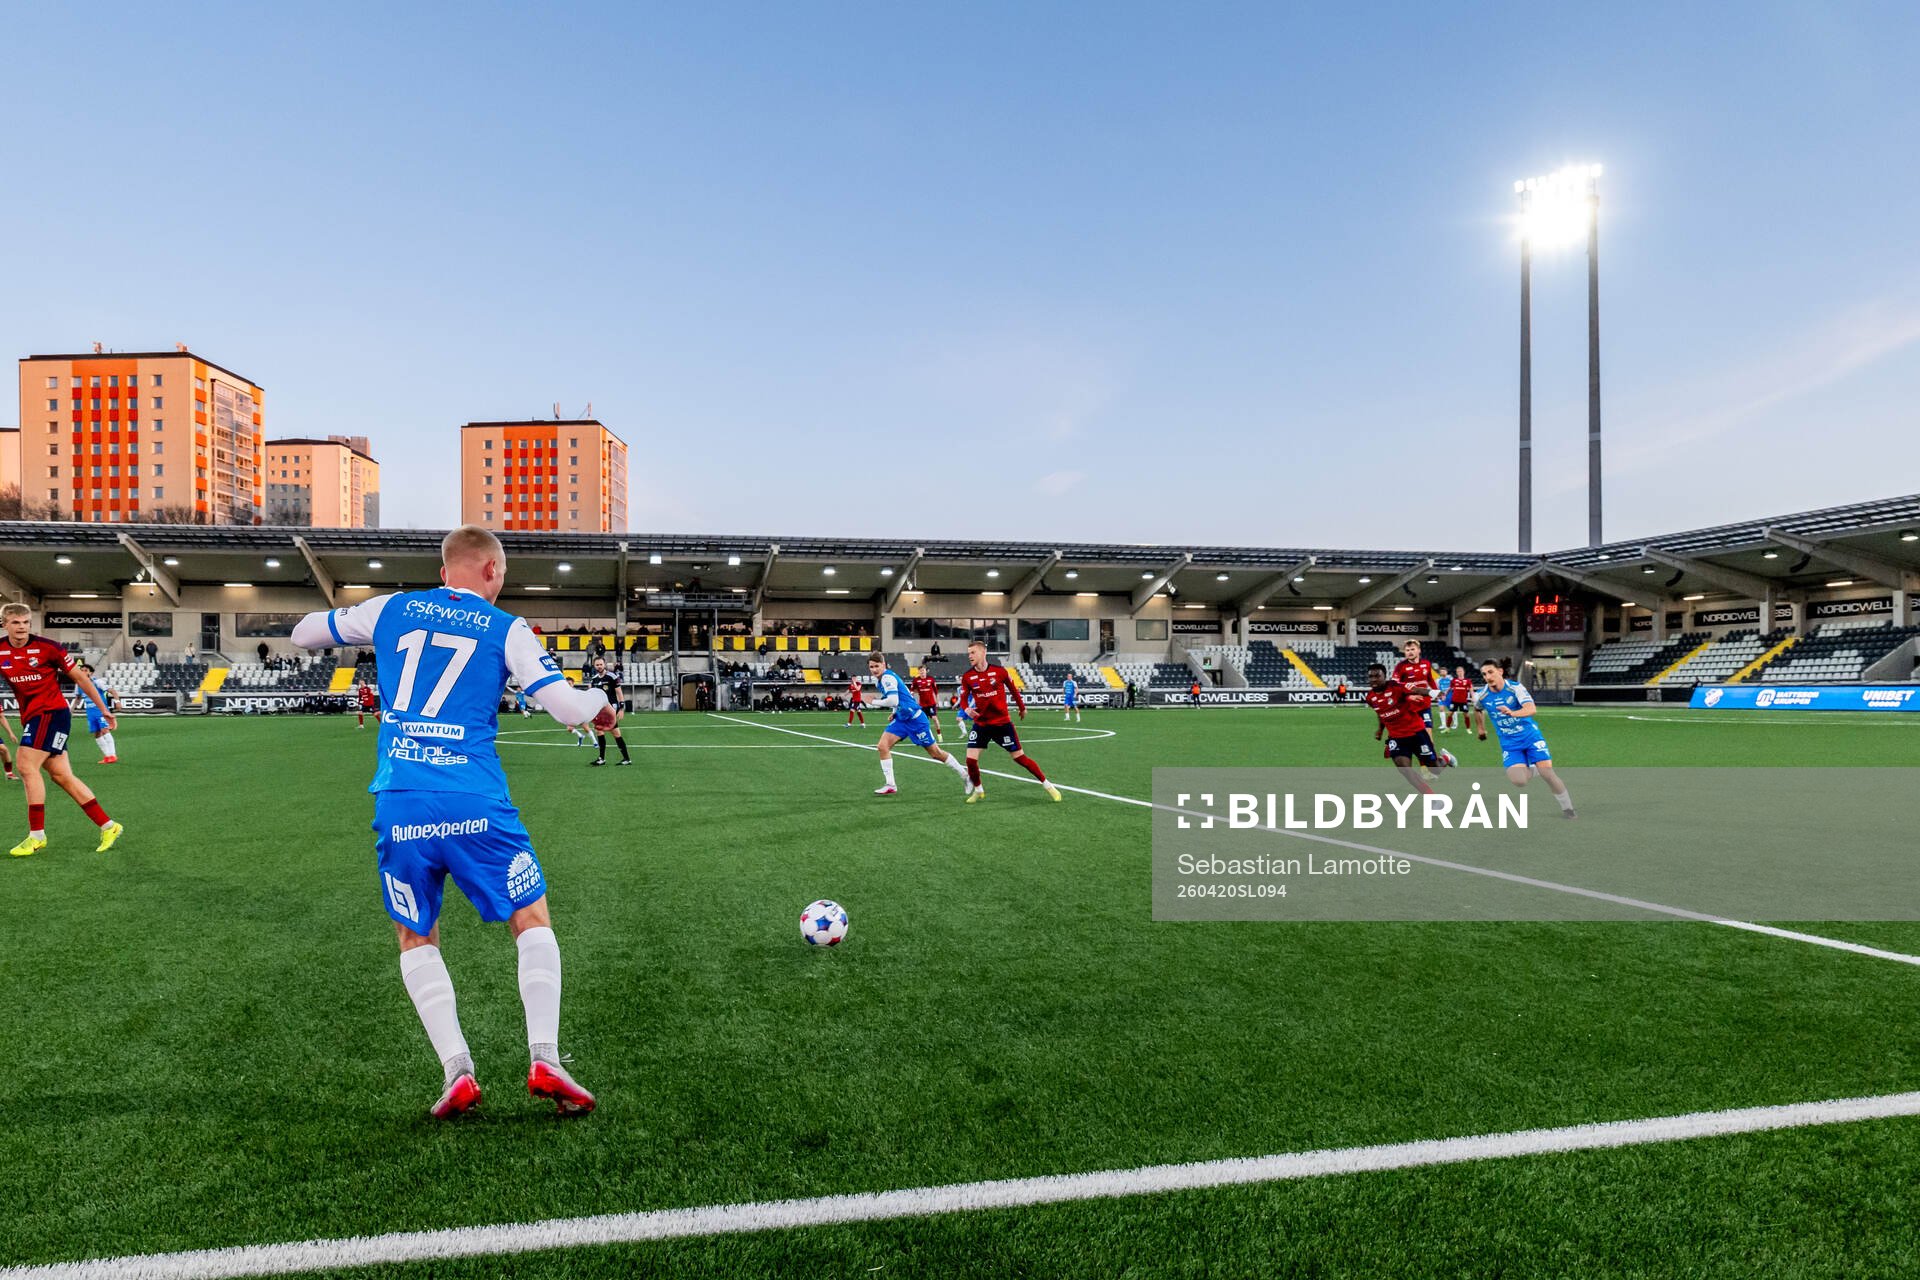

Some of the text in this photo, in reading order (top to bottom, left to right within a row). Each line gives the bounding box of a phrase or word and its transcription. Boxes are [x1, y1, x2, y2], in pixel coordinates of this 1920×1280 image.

[406, 600, 492, 629] esteworld
[392, 629, 478, 718] 17
[1862, 690, 1915, 702] UNIBET
[405, 723, 461, 736] KVANTUM
[392, 818, 489, 843] Autoexperten
[507, 862, 538, 890] BOHUS
